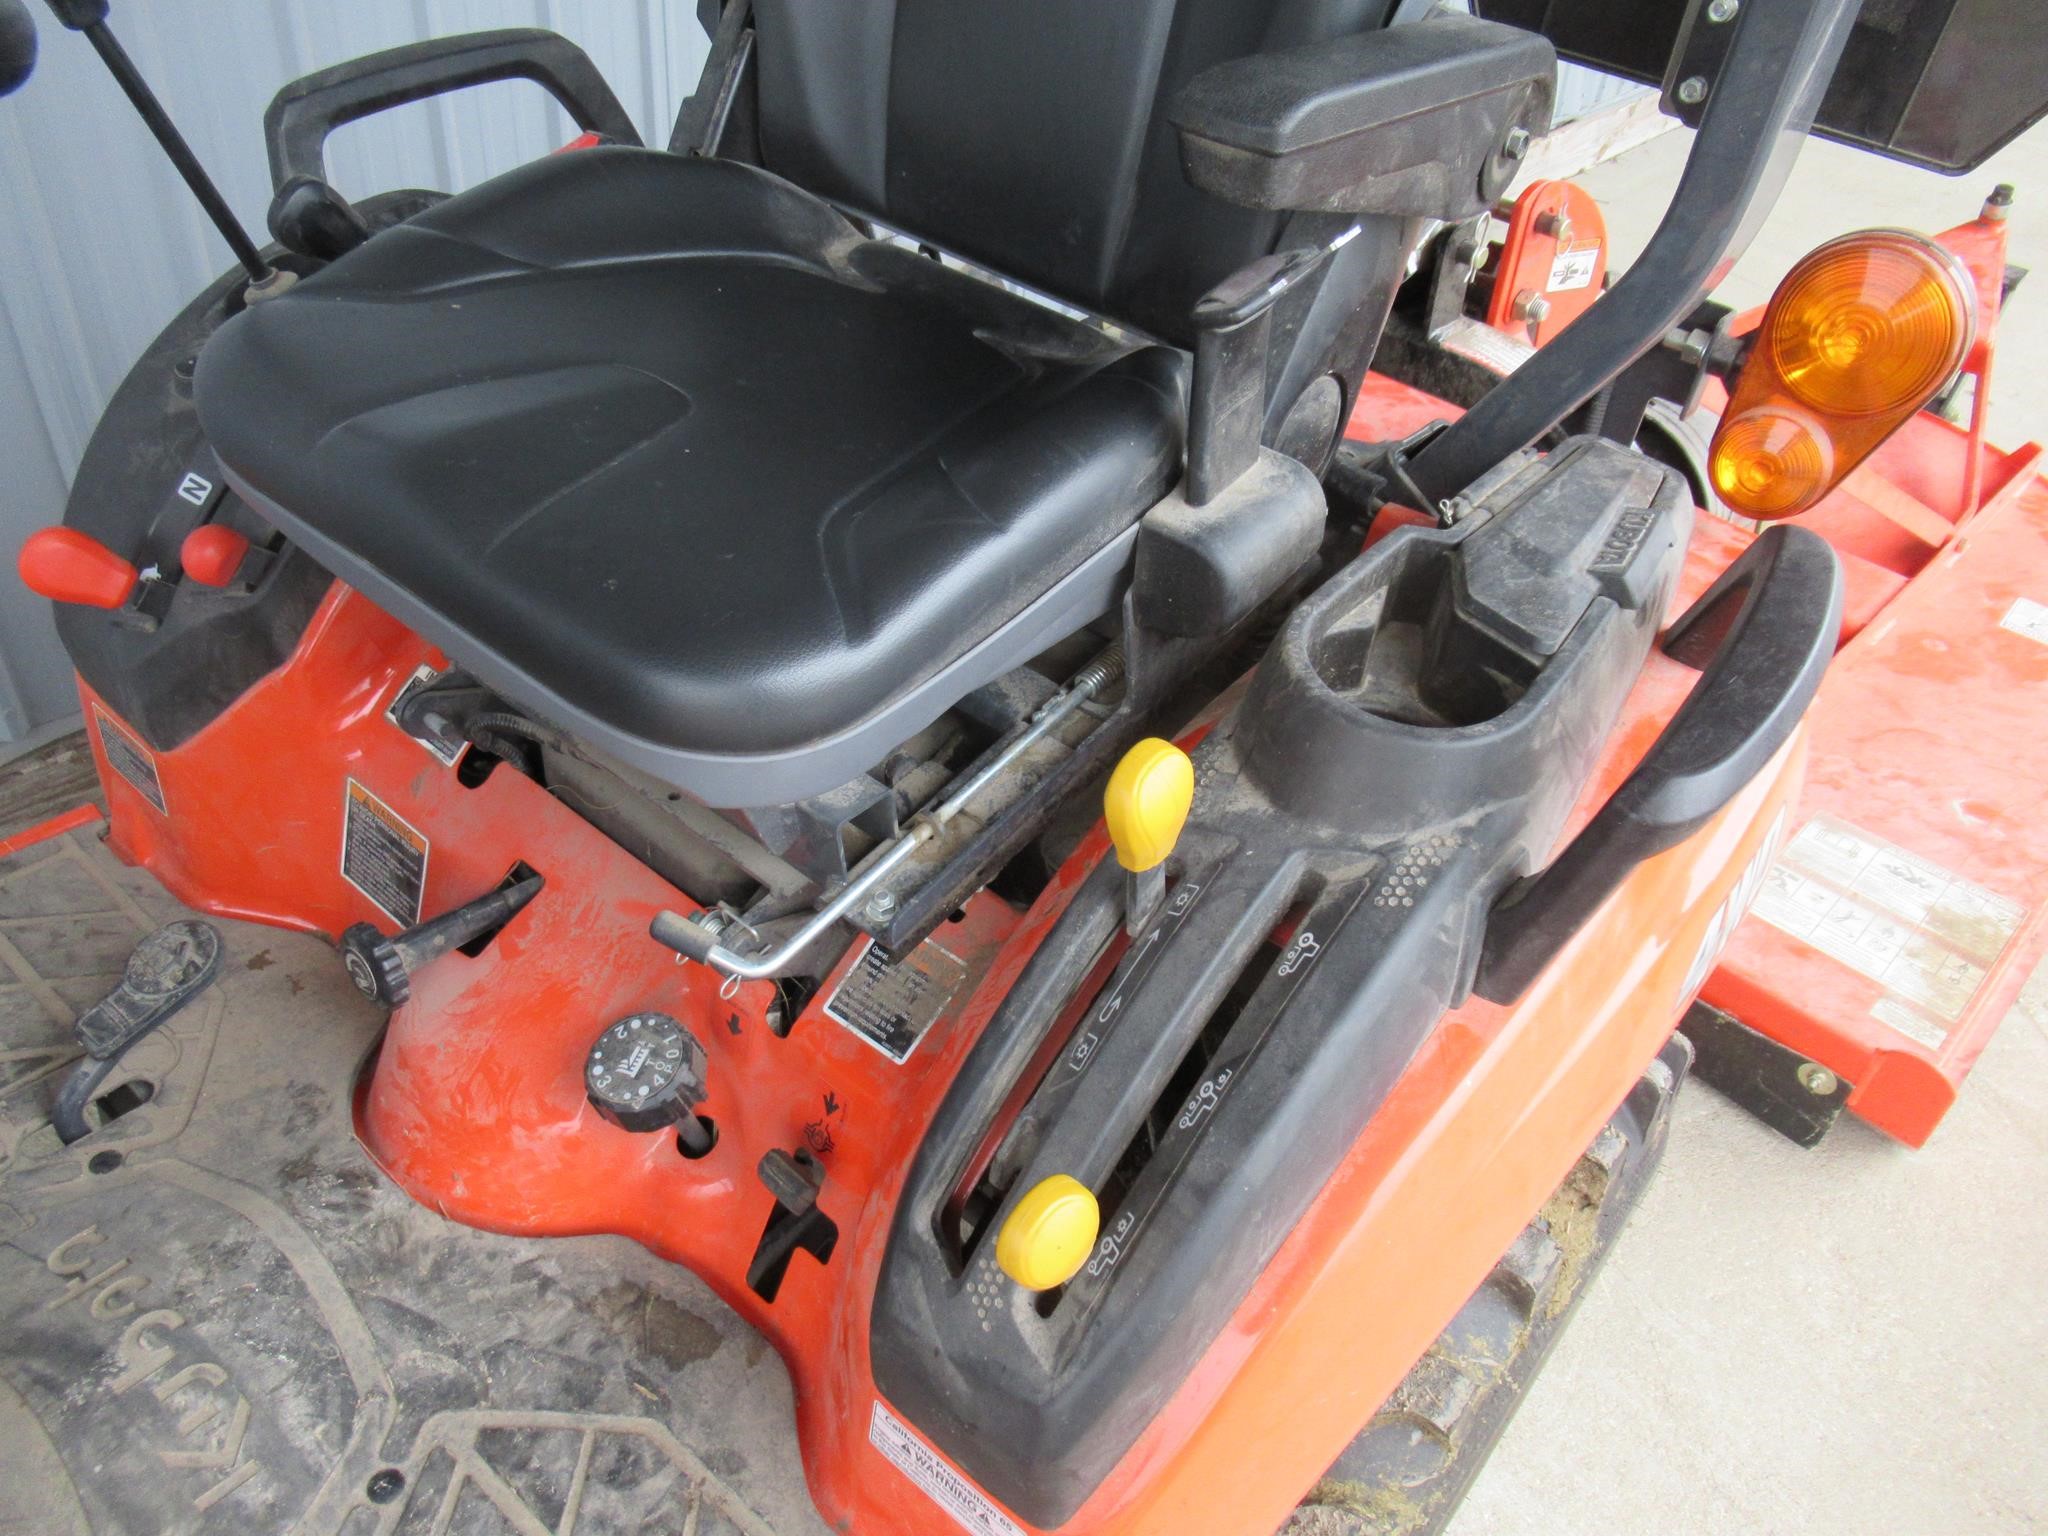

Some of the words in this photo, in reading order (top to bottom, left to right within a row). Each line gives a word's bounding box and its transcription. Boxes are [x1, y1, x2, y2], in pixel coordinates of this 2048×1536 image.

[182, 477, 208, 501] N
[614, 1025, 628, 1039] 2
[663, 1034, 678, 1045] 1
[665, 1049, 679, 1059] 0
[597, 1075, 612, 1088] 3
[654, 1074, 665, 1086] 4
[884, 1415, 933, 1461] California
[935, 1460, 998, 1518] Proposition
[999, 1515, 1014, 1532] 65
[914, 1453, 978, 1513] WARNING
